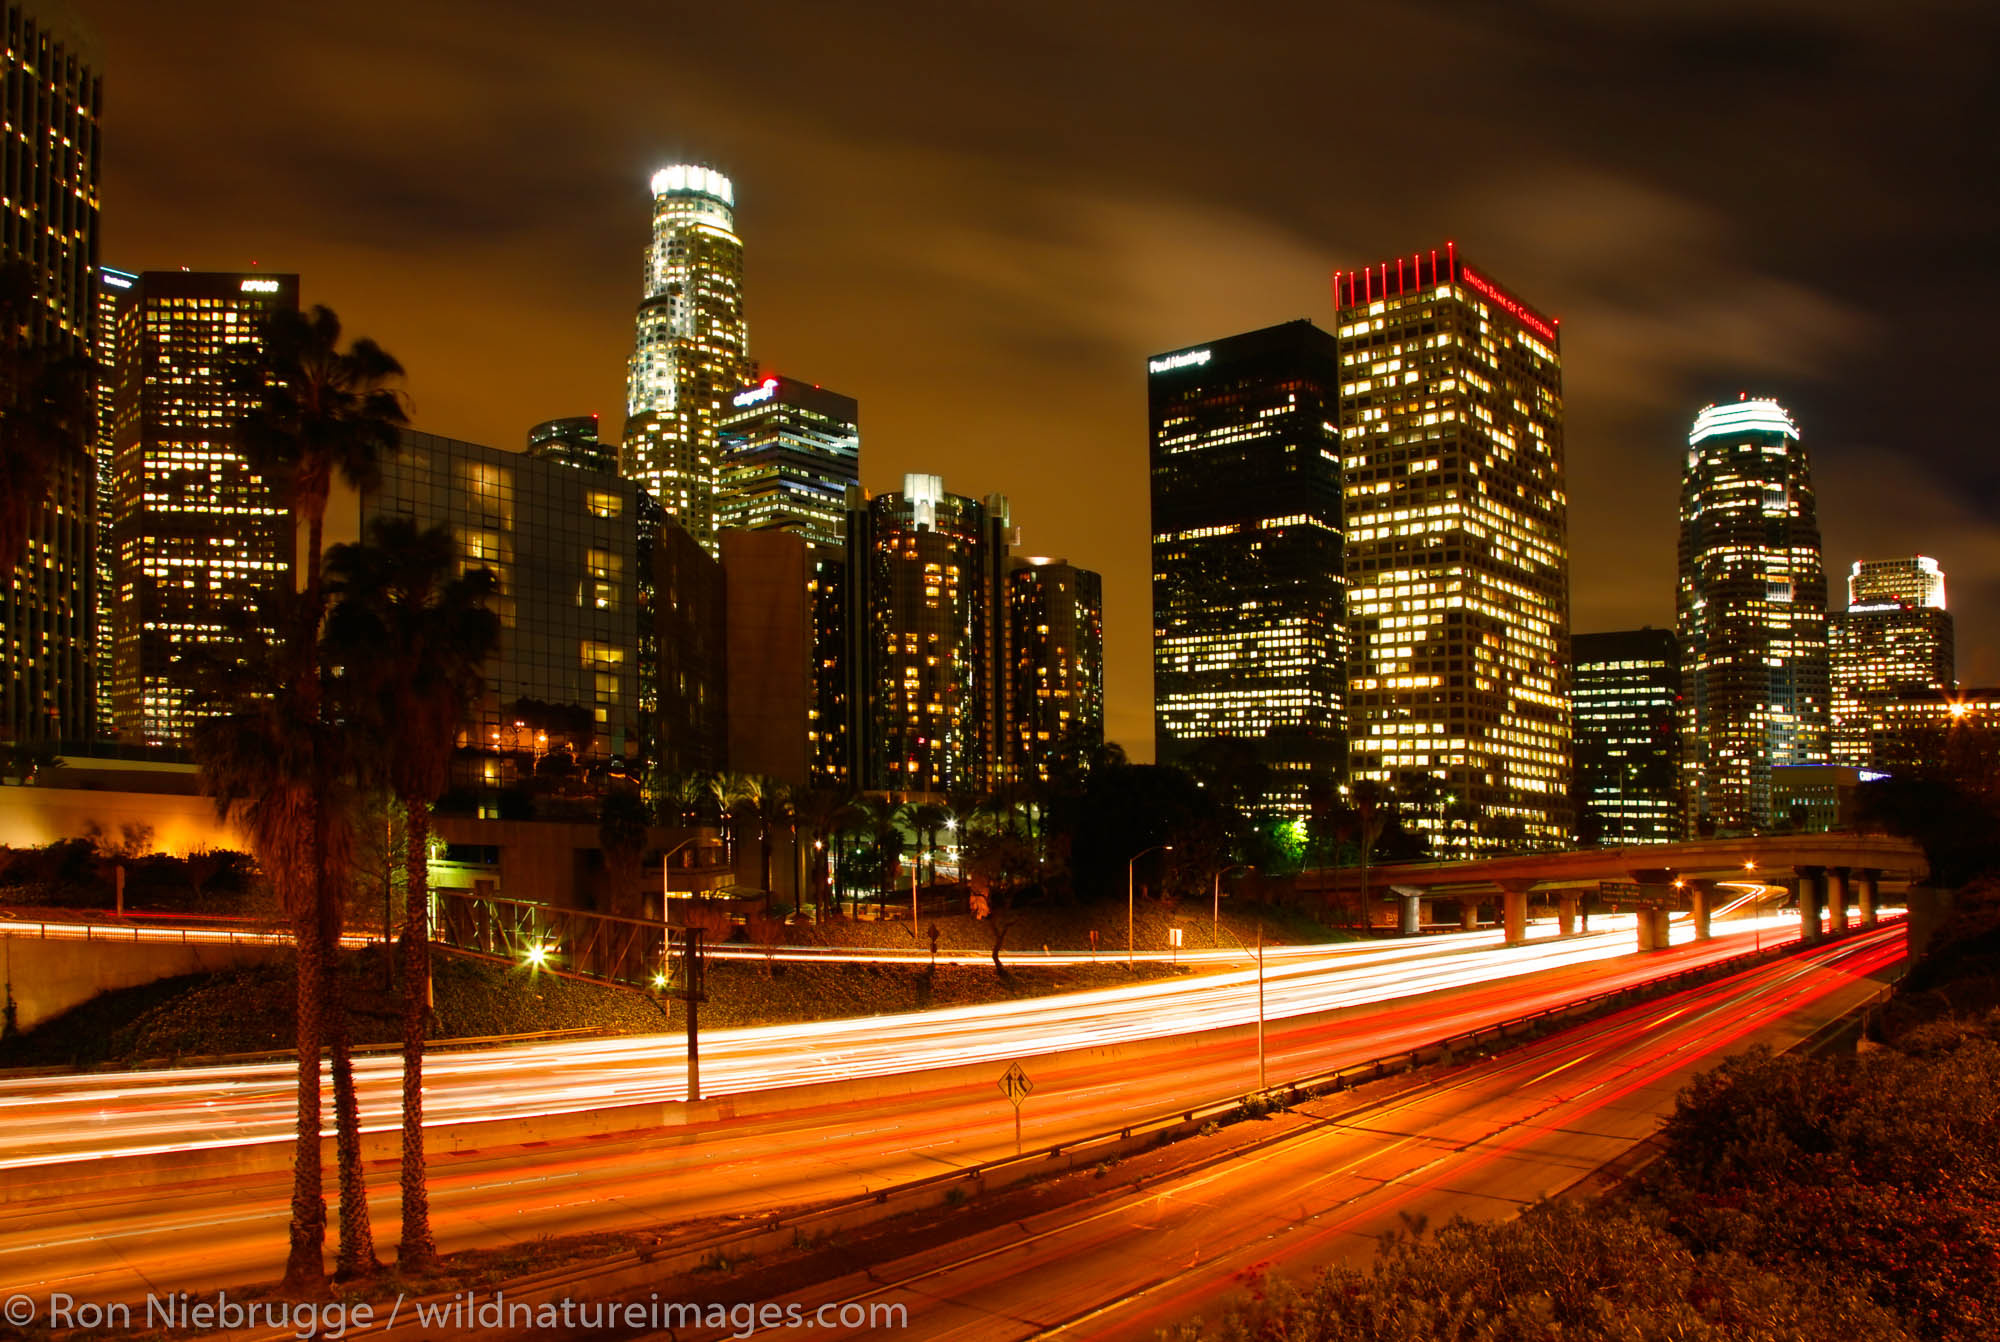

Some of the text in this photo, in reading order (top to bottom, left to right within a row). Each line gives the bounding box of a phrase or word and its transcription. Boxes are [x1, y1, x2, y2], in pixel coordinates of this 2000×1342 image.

[1463, 267, 1488, 293] UNION
[1489, 285, 1507, 307] BANK
[1518, 306, 1554, 340] CALIFORNIA
